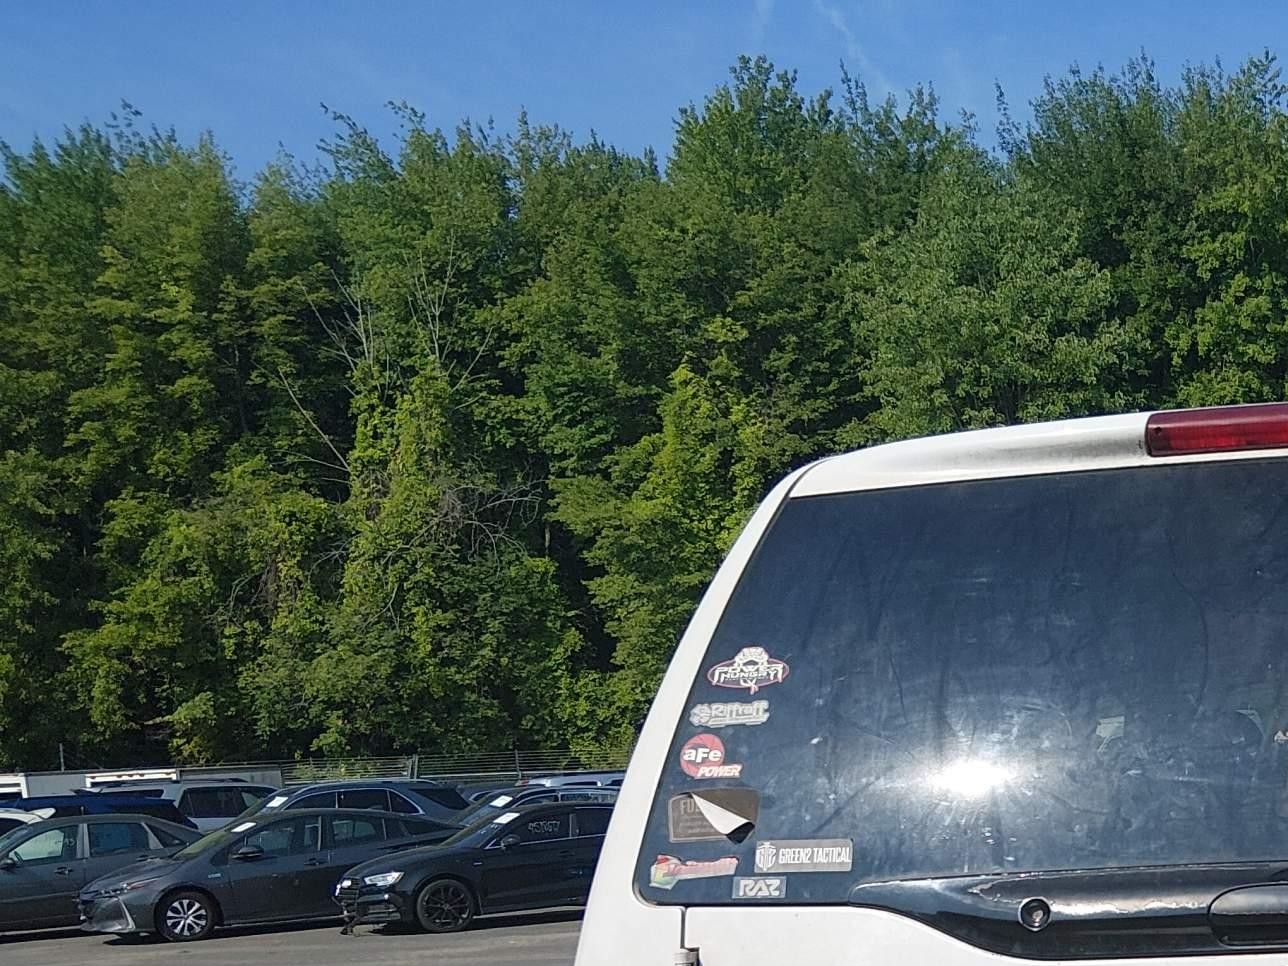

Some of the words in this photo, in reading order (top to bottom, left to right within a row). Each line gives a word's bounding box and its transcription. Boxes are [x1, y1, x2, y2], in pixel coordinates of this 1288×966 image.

[683, 746, 722, 763] aFe
[697, 763, 742, 778] POWER
[778, 847, 811, 864] GREEN2
[813, 846, 852, 863] TACTICAL
